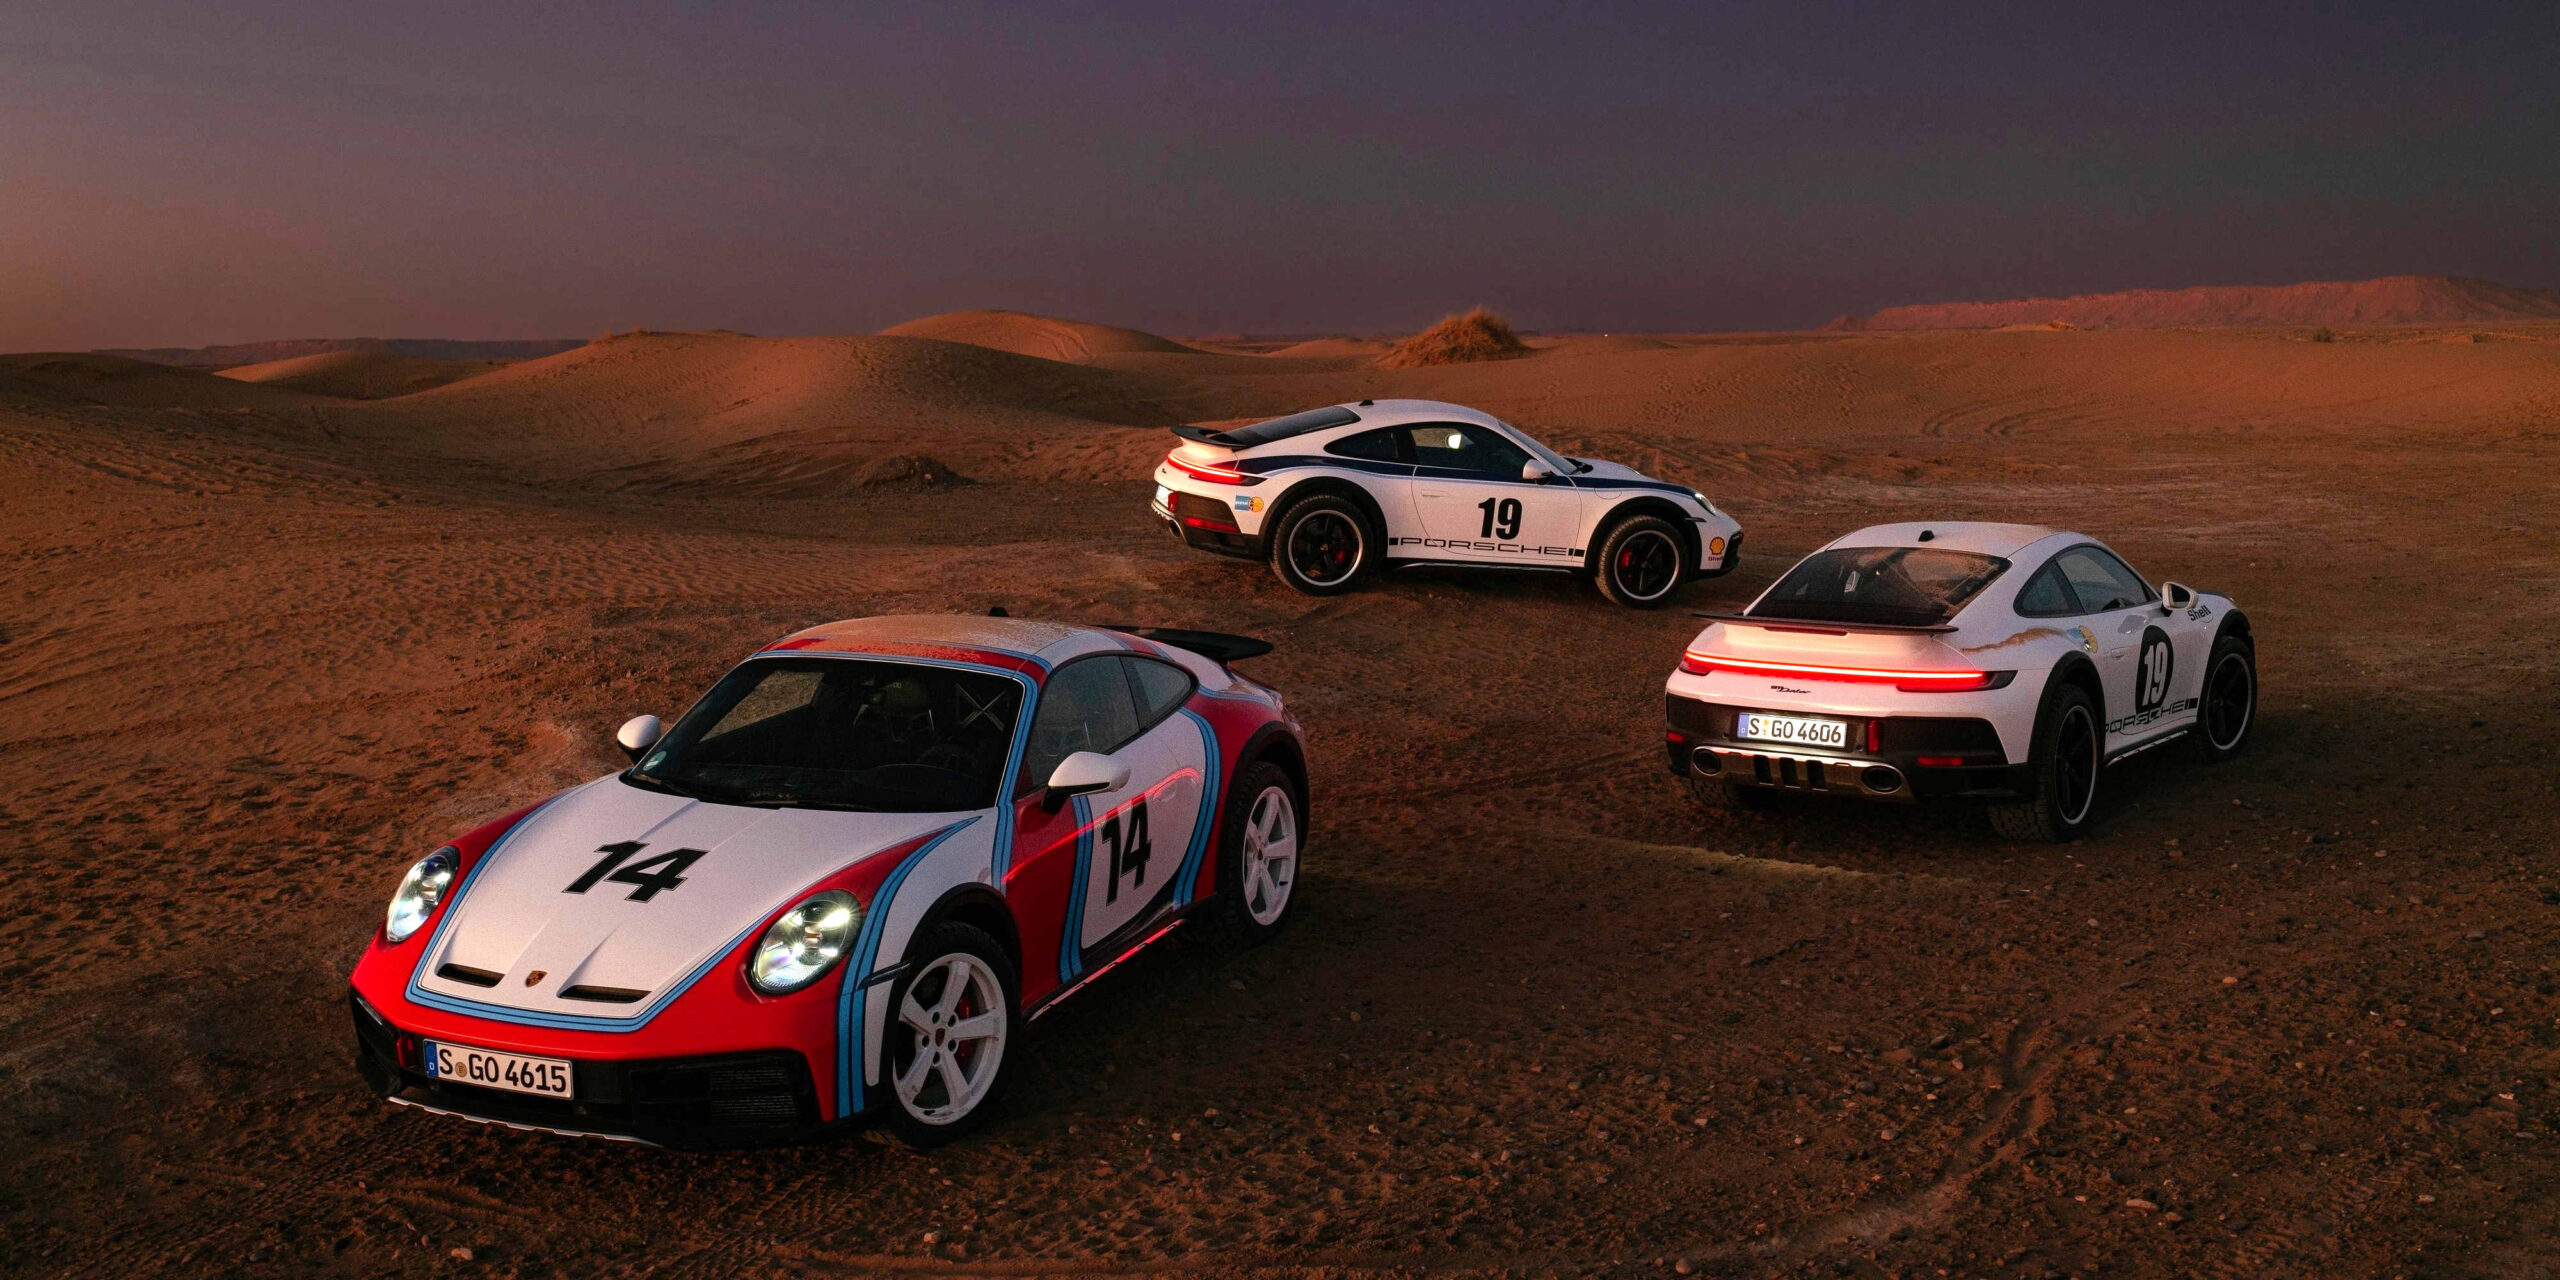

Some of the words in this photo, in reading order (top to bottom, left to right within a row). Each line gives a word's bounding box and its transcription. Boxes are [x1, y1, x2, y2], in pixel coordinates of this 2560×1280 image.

[1478, 497, 1523, 540] 19
[1400, 537, 1567, 556] PORSCHE
[2187, 604, 2212, 621] Shell
[2141, 641, 2168, 706] 19
[1748, 718, 1760, 736] S
[1771, 720, 1794, 738] GO
[1797, 722, 1842, 743] 4606
[1101, 793, 1152, 907] 14
[561, 840, 711, 904] 14
[439, 1049, 453, 1075] S
[468, 1053, 499, 1083] GO
[504, 1059, 567, 1093] 4615
